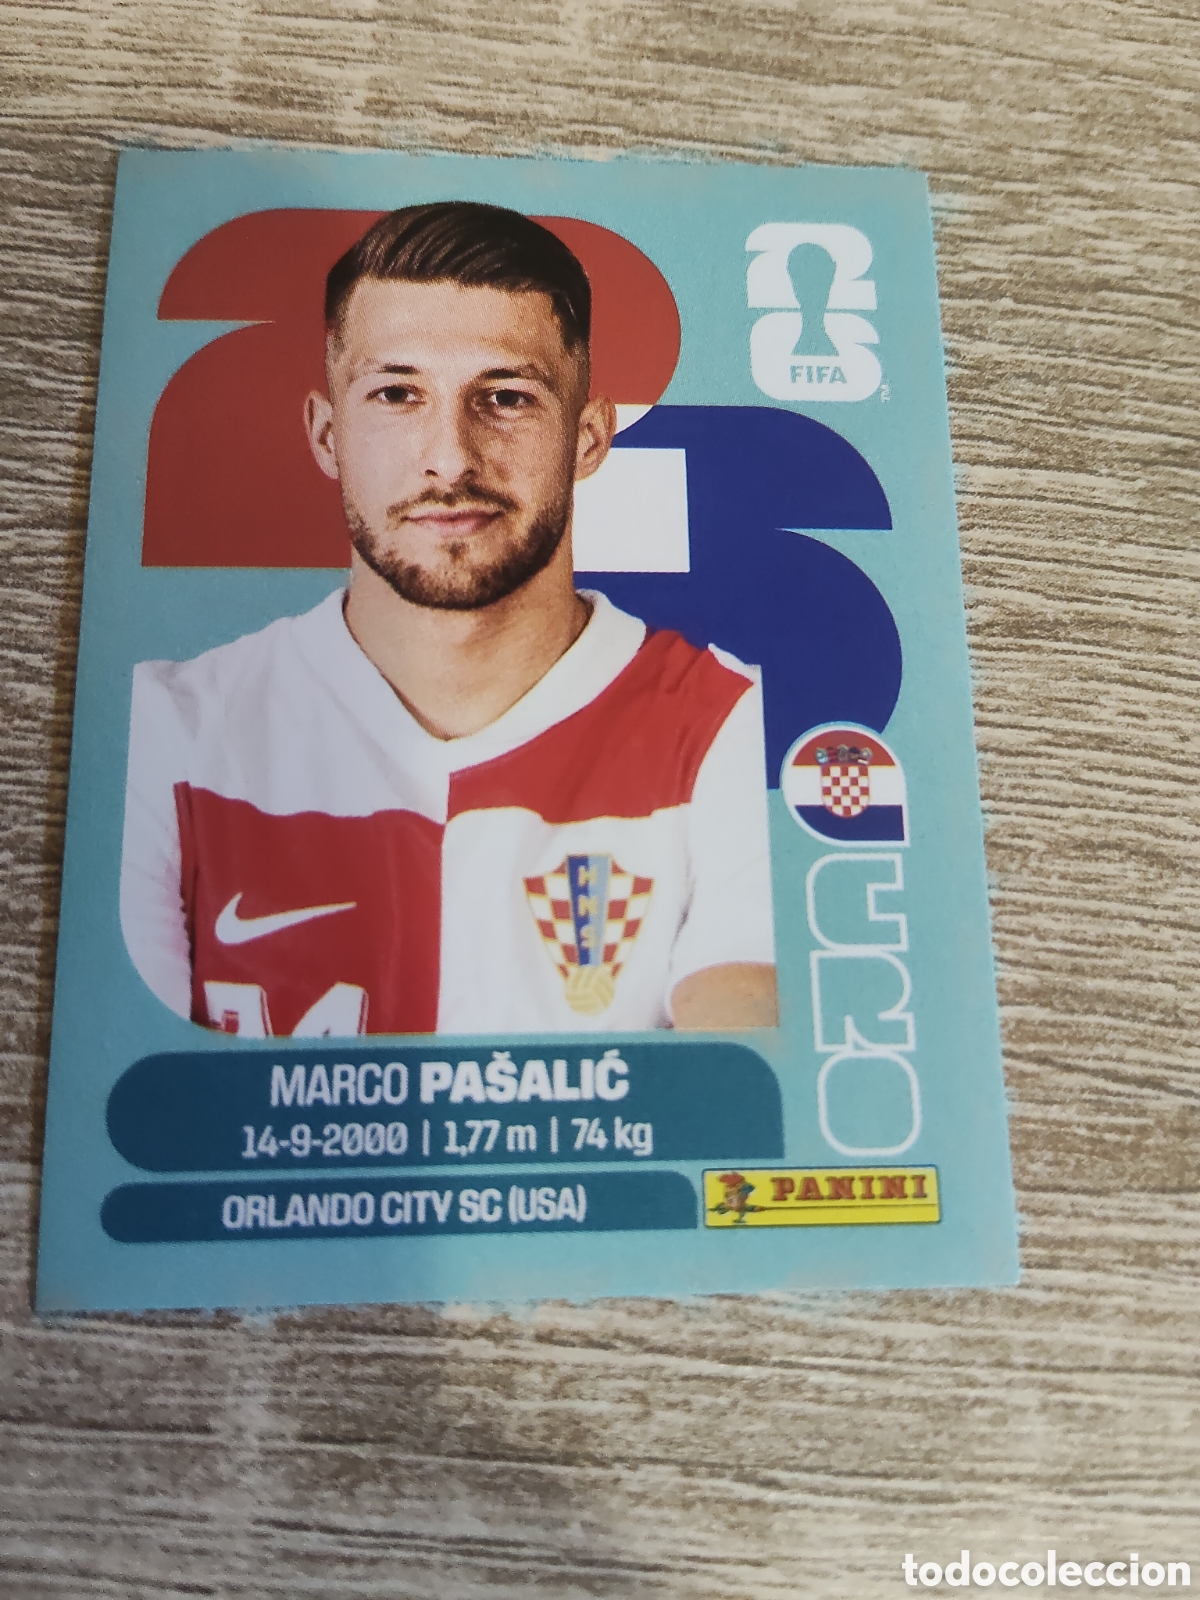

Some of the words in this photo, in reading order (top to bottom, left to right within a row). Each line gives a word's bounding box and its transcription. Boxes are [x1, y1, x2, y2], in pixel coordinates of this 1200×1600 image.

[789, 365, 848, 385] FIFA
[804, 852, 923, 1157] CRO
[270, 1063, 408, 1108] MARCO
[419, 1050, 630, 1105] PAŠALIĆ
[240, 1121, 408, 1159] 14-9-2000
[444, 1119, 502, 1157] 1,77
[505, 1122, 538, 1153] m
[570, 1117, 609, 1152] 74
[614, 1116, 653, 1157] kg
[221, 1193, 375, 1229] ORLANDO
[380, 1189, 454, 1224] CITY
[459, 1188, 503, 1223] SC
[509, 1184, 587, 1224] (USA)
[770, 1174, 928, 1202] PANINI
